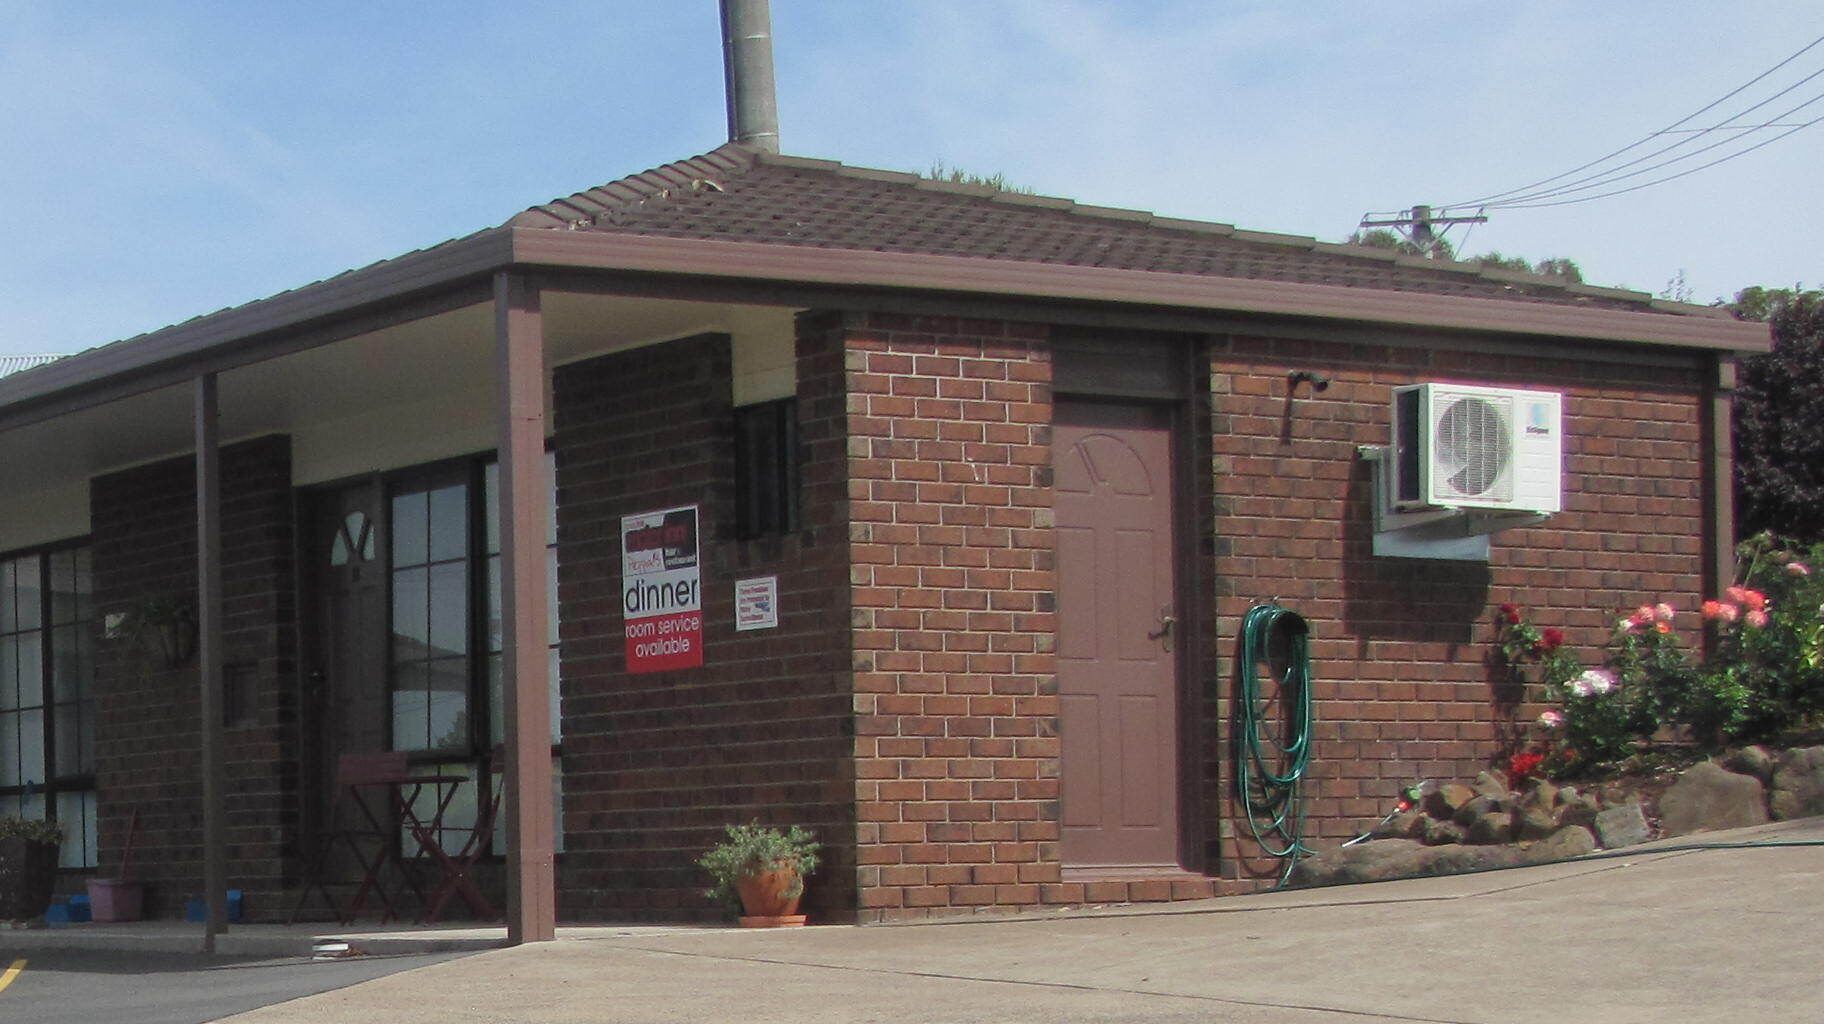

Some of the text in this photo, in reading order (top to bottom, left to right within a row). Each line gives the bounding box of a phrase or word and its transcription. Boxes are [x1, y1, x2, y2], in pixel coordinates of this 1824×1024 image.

[626, 579, 698, 612] dinner
[625, 615, 699, 638] room service
[636, 636, 690, 658] available
